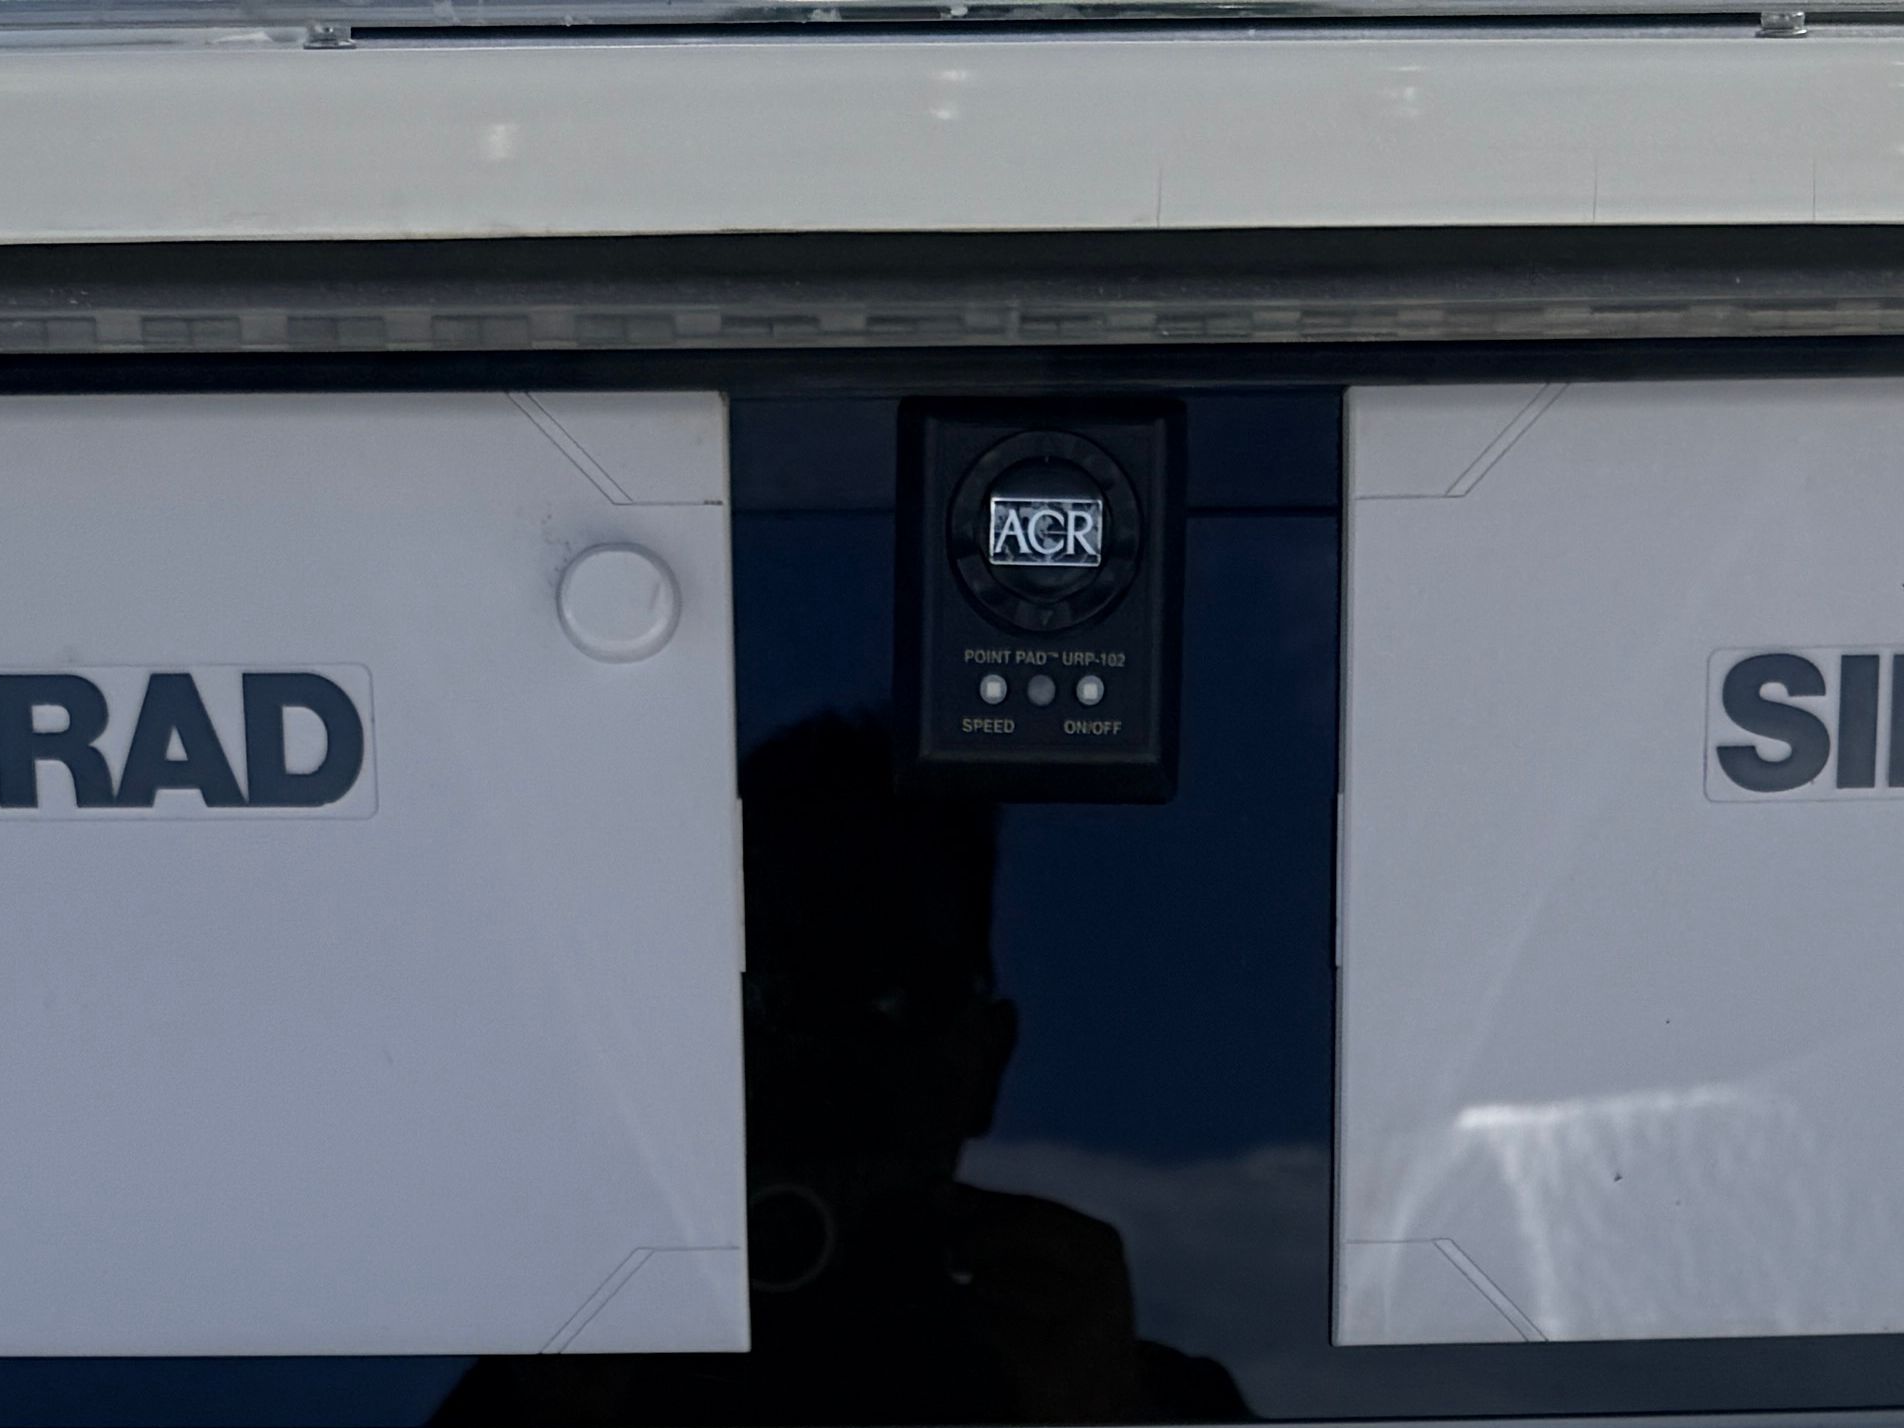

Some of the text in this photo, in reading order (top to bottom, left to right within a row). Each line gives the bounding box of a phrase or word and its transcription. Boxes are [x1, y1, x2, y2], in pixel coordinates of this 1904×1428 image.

[995, 508, 1102, 556] ACR
[964, 650, 1011, 665] POINT
[1062, 652, 1126, 668] URP-102
[963, 718, 1014, 734] SPEED
[1064, 720, 1121, 735] ON/OFF
